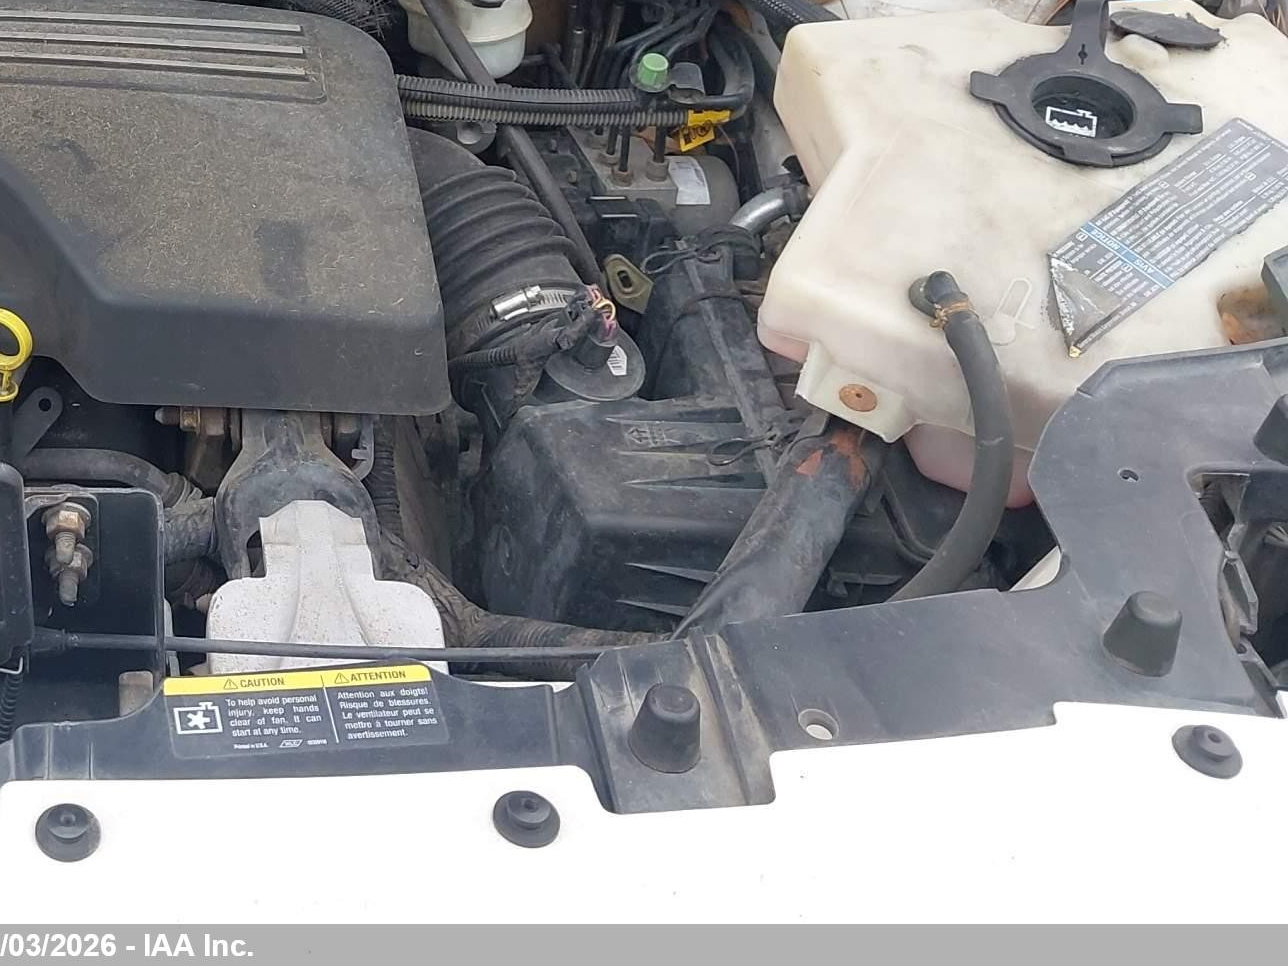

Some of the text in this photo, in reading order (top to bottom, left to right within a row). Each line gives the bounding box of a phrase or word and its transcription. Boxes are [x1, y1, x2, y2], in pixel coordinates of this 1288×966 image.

[350, 670, 406, 681] ATTENTION
[240, 677, 285, 688] CAUTION
[337, 691, 375, 700] Attention
[400, 686, 428, 697] doigts!
[225, 694, 317, 707] To help avoid personal
[339, 697, 431, 709] Risque de blessures.
[263, 706, 284, 716] keep
[293, 704, 319, 713] hands
[342, 711, 353, 719] Le
[356, 709, 399, 718] ventilateur
[402, 707, 421, 717] peut
[230, 715, 322, 727] clear of fan. It can
[345, 717, 437, 730] mettre à tourner sans
[232, 726, 302, 737] start at any time.
[347, 728, 409, 740] avertissement.
